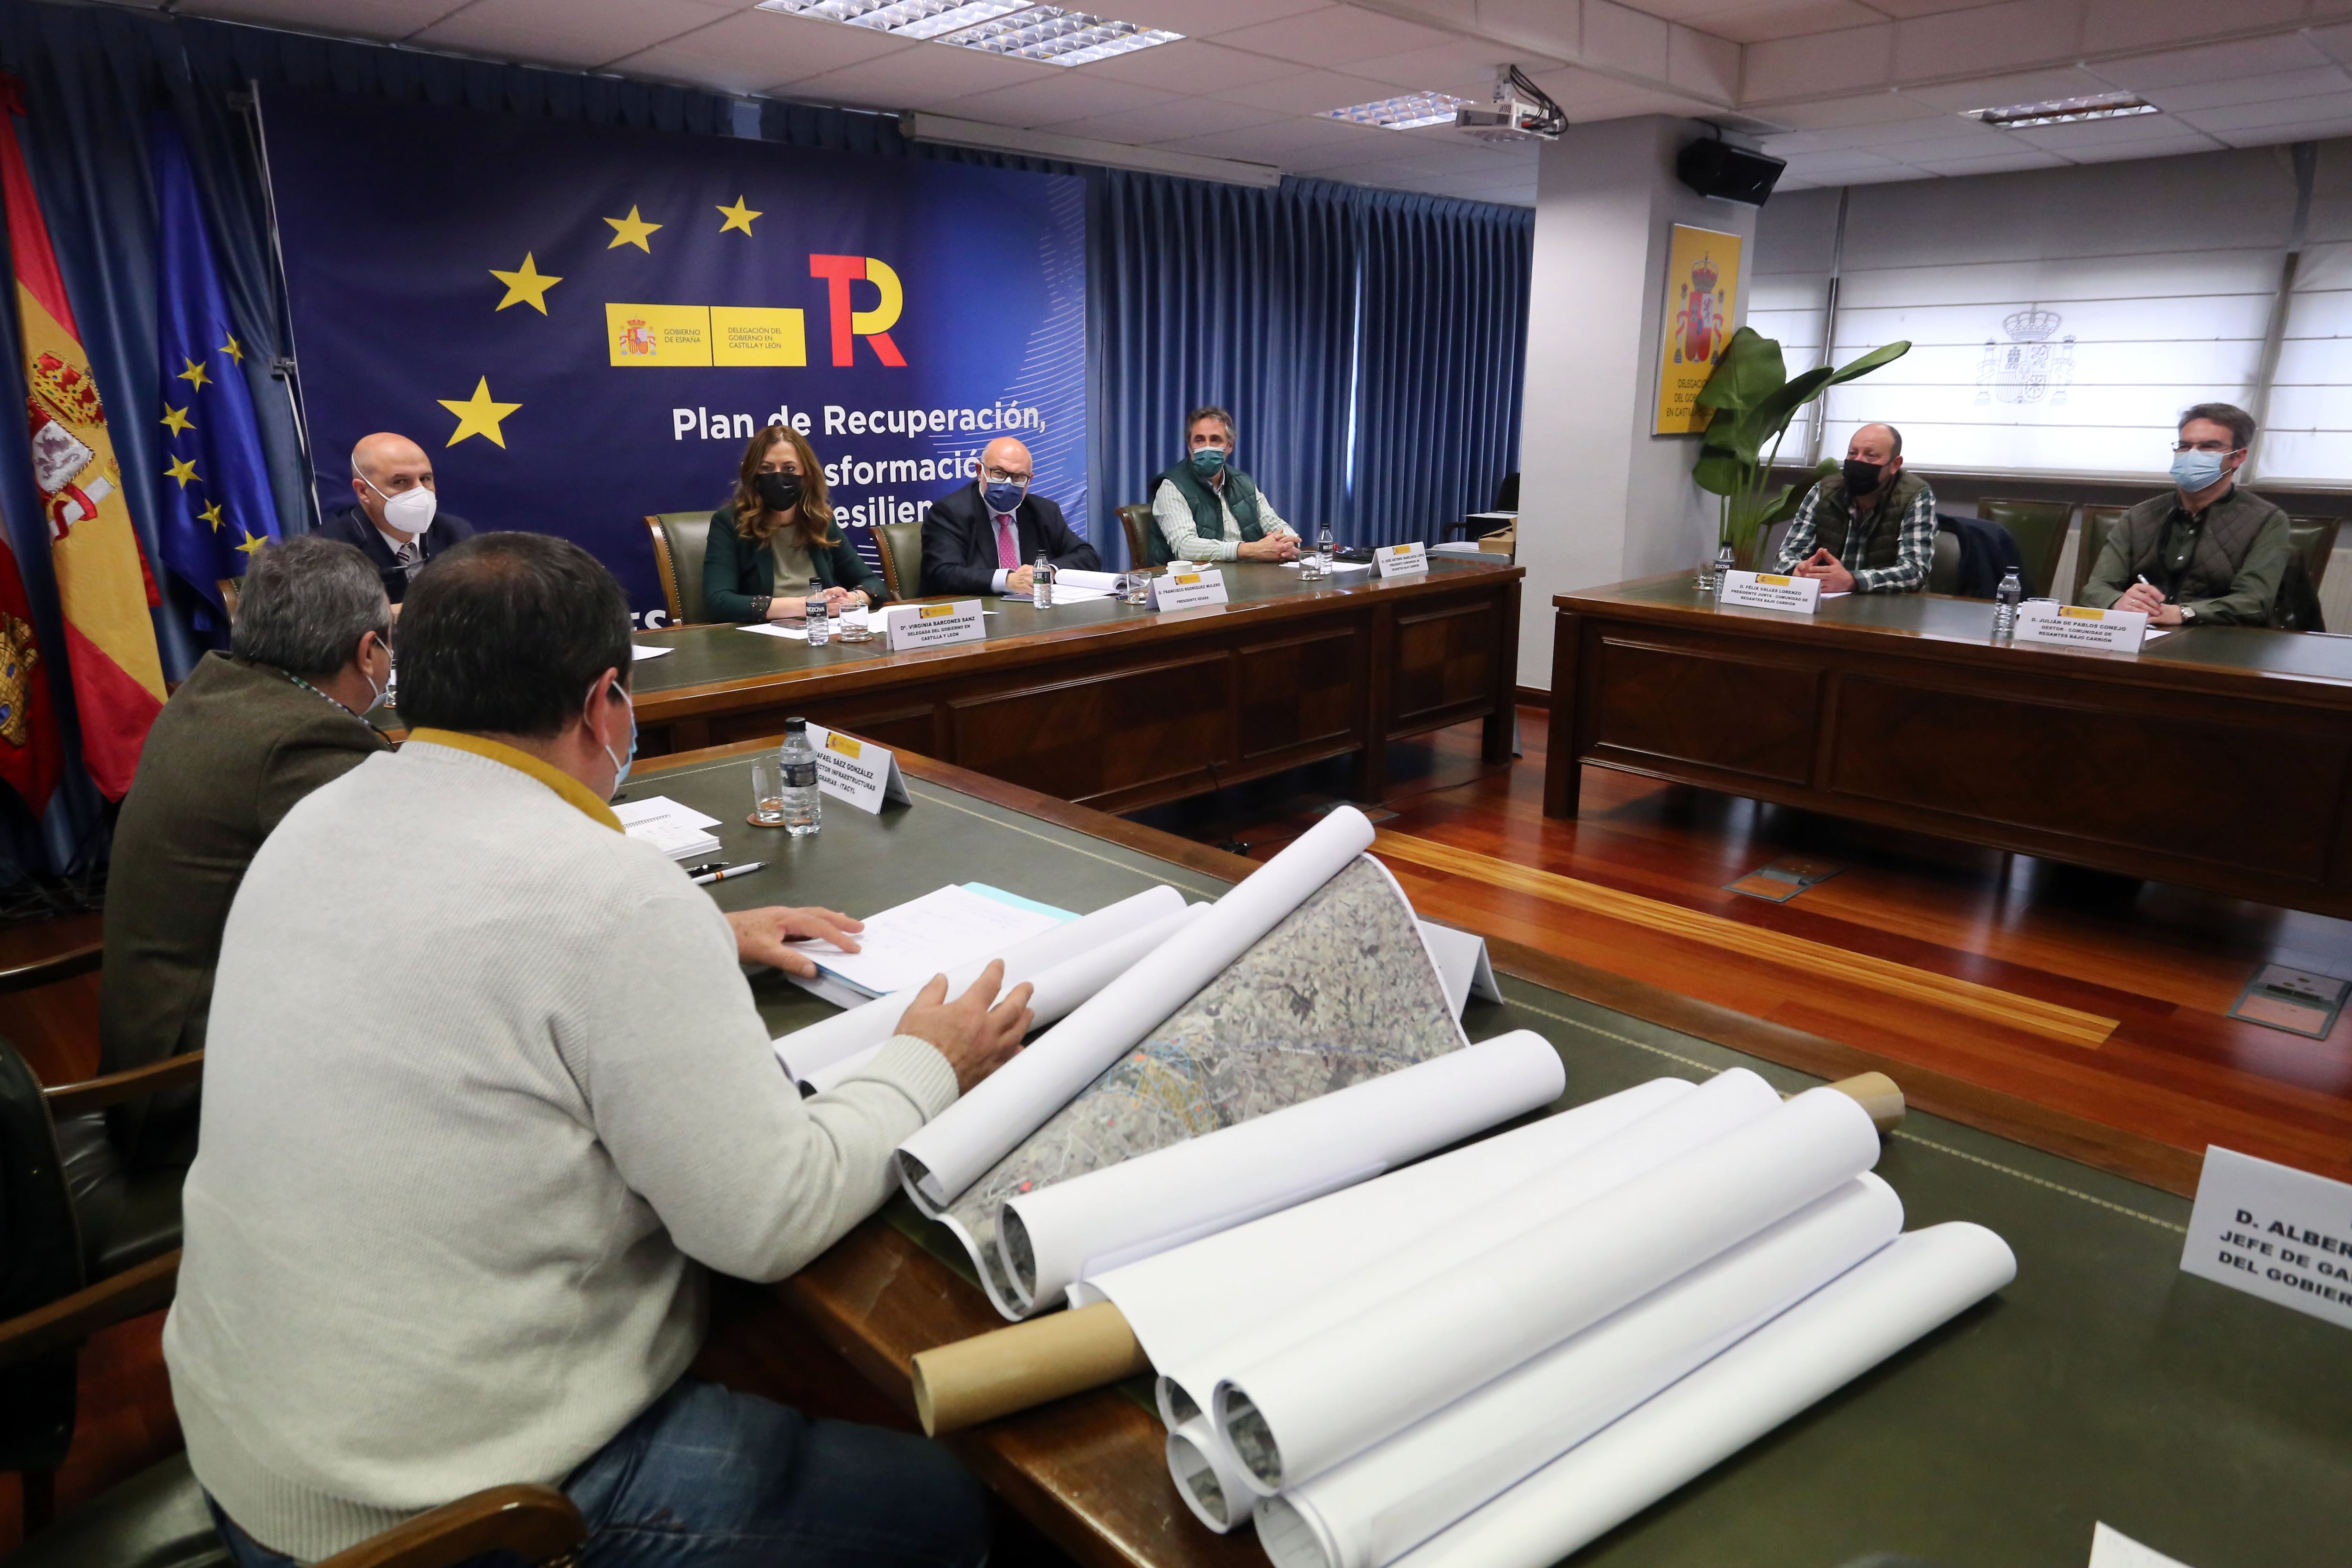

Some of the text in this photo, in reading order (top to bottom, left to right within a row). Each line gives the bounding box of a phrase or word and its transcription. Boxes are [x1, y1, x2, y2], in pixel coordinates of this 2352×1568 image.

[1674, 393, 1684, 402] DEL
[1677, 379, 1706, 388] DELEGACI
[673, 399, 1046, 440] Plan de Recuperación,
[1667, 407, 1674, 417] EN
[824, 449, 979, 487] sformació
[833, 495, 933, 529] esilien
[817, 763, 875, 791] ECTOR INFRAESTRUCTURAS
[818, 774, 837, 786] GRARIAS
[840, 783, 855, 794] ITACYL
[833, 758, 846, 768] SÁEZ
[847, 764, 874, 779] GONZÁLEZ
[2236, 1209, 2352, 1259] D. ALBER
[2220, 1231, 2352, 1283] JEFE DE GA
[2218, 1250, 2352, 1306] DEL GOBIER
